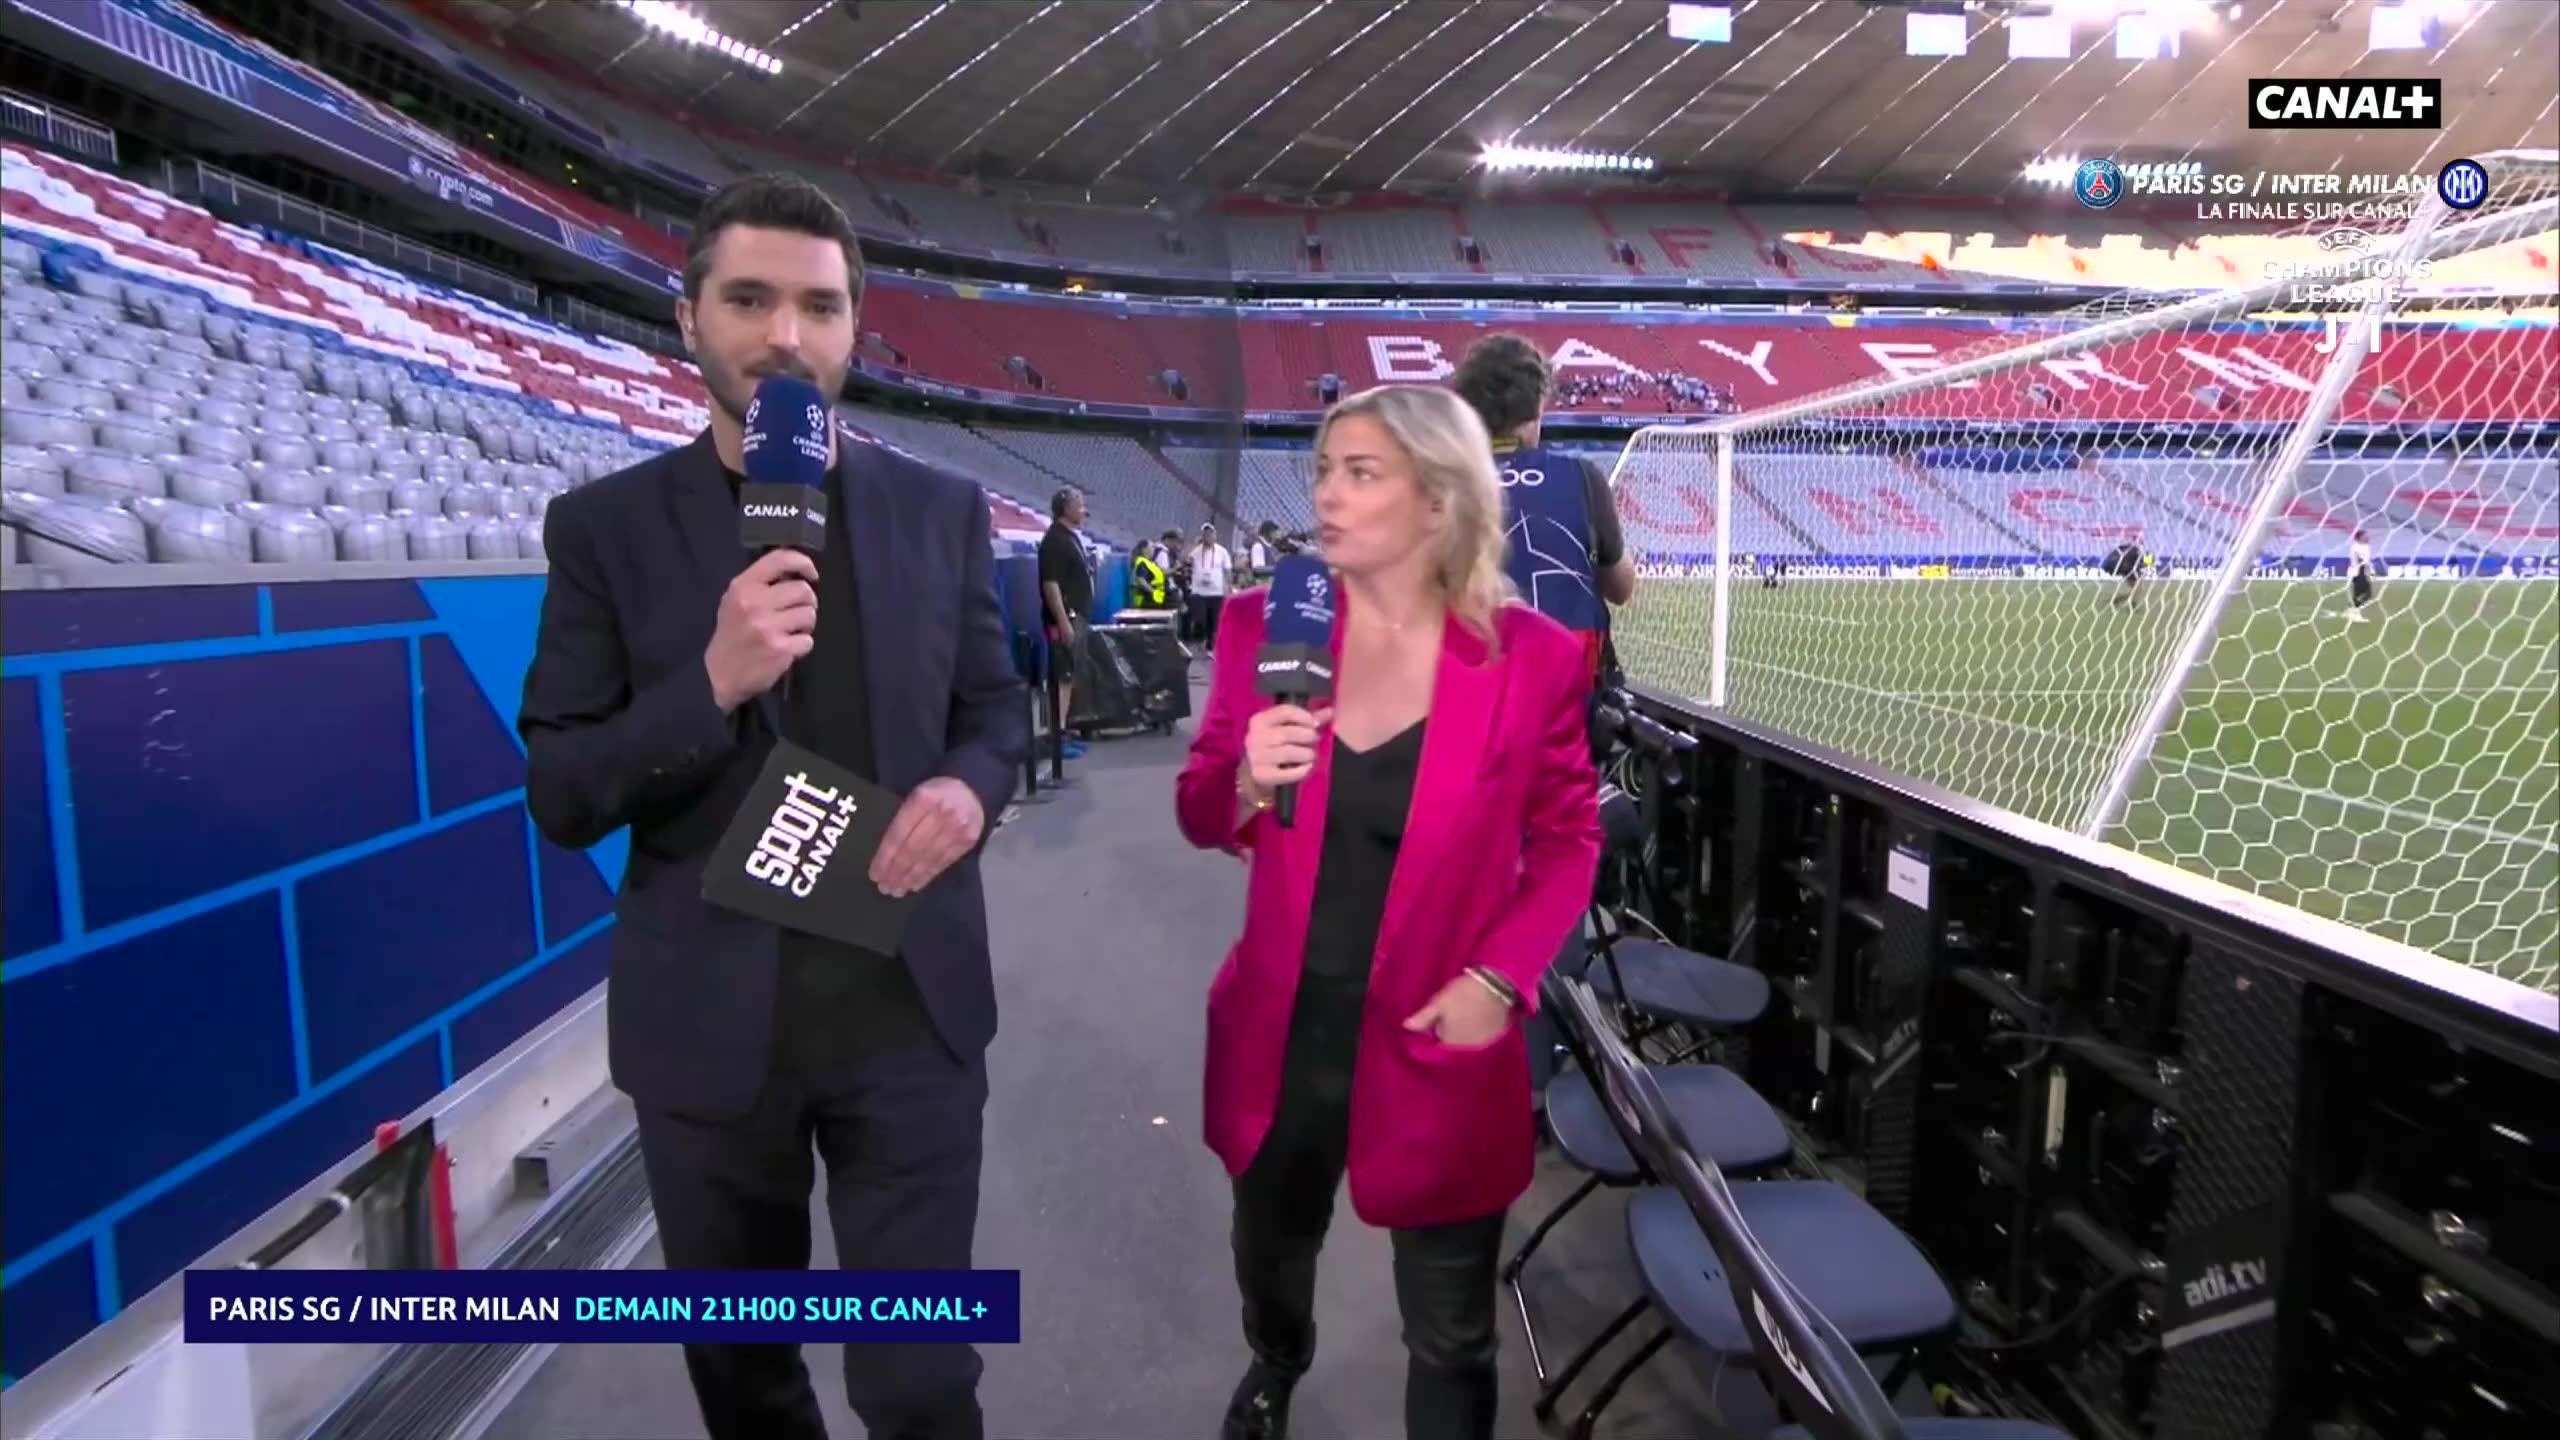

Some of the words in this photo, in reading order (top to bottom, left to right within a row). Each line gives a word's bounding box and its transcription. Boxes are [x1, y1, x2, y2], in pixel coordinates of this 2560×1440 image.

[743, 503, 799, 517] CANAL+
[1785, 563, 1879, 578] crypto.com
[745, 772, 839, 887] sport
[791, 795, 857, 897] CANAL+
[2183, 1256, 2266, 1308] adi.tv
